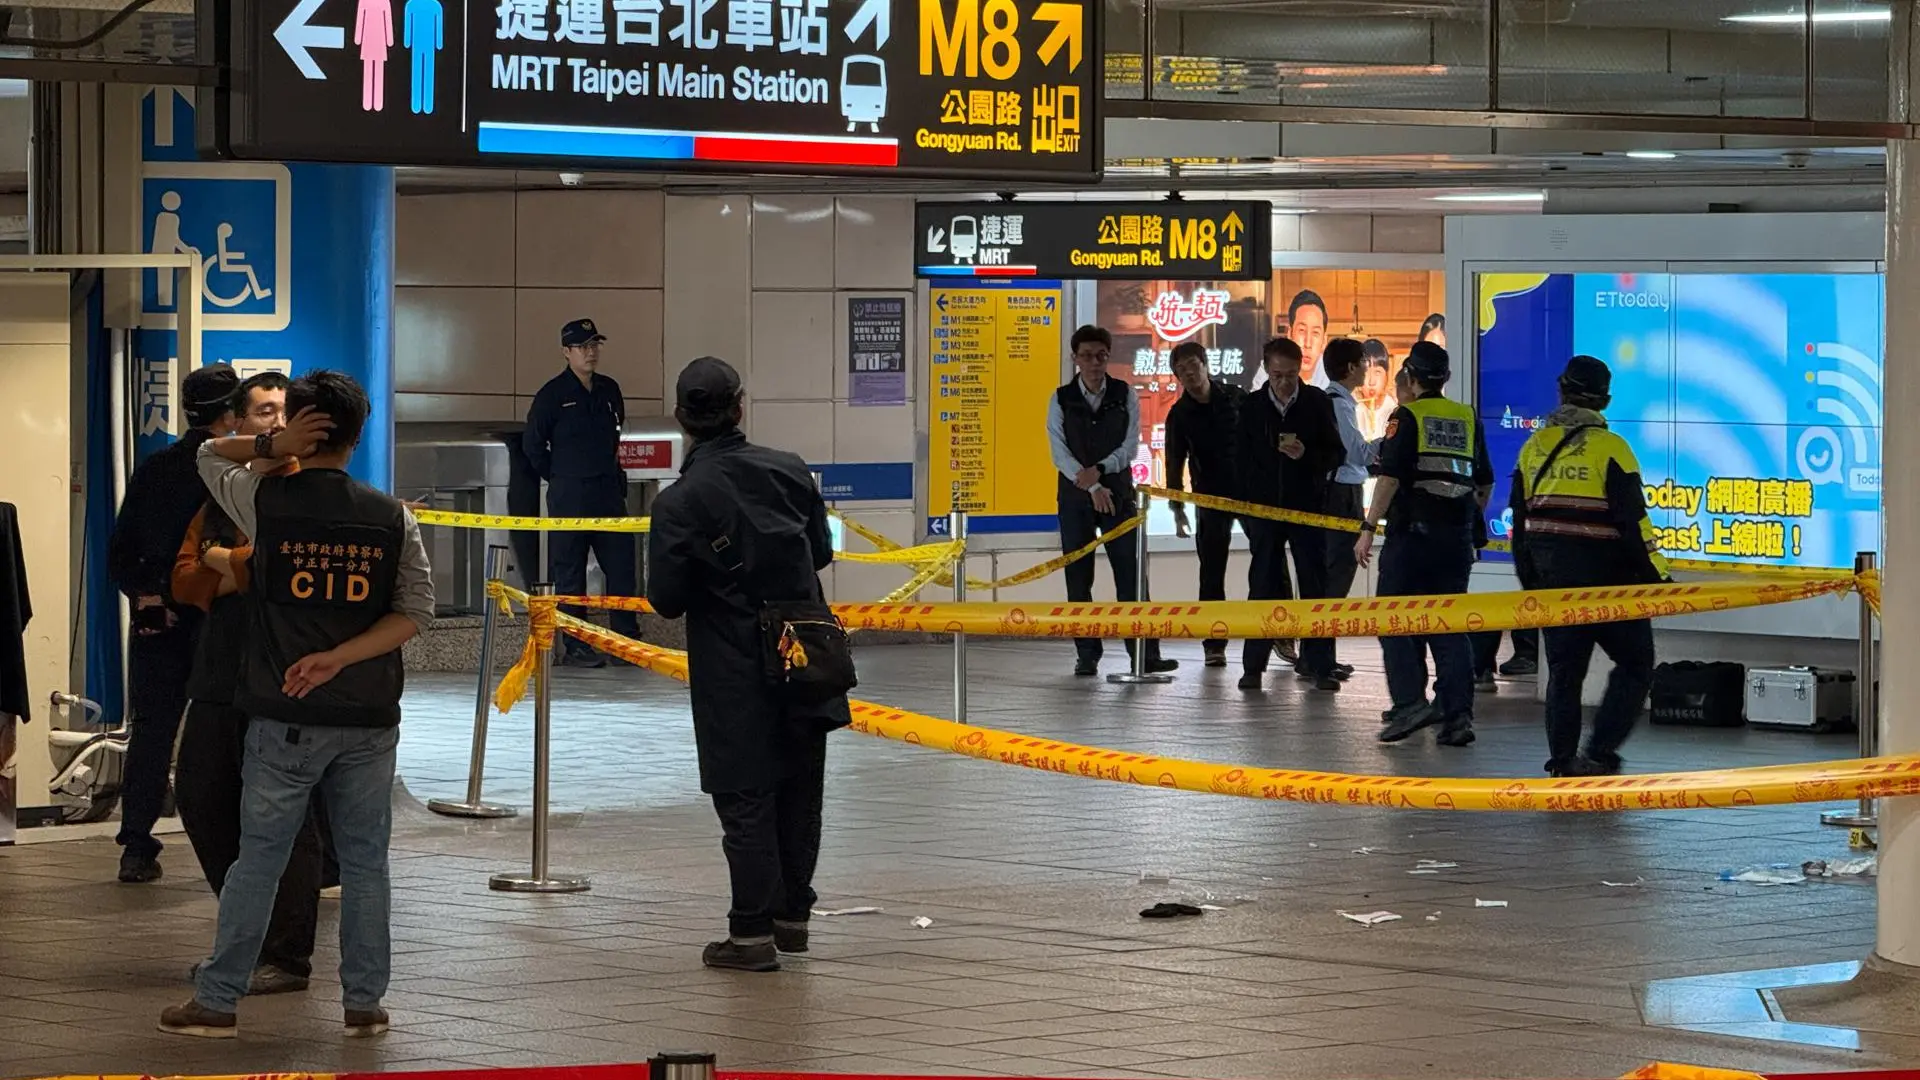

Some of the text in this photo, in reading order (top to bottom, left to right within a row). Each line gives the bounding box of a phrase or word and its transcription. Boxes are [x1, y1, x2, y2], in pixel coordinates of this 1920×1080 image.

[496, 0, 828, 56] 捷運台北車站
[919, 0, 1020, 80] M8
[492, 54, 828, 103] MRT Taipei Main Station
[940, 89, 1022, 126] 公園路
[1031, 84, 1080, 153] 出口
[915, 127, 1022, 153] Gongyuan Rd.
[1056, 134, 1081, 153] EXIT
[980, 215, 1024, 246] 捷運
[1097, 215, 1164, 245] 公園路
[1169, 218, 1217, 260] M8
[979, 248, 1010, 265] MRT
[1070, 249, 1164, 269] Gongyuan Rd.
[1151, 294, 1223, 328] 統一麵
[1596, 290, 1669, 313] ETtoday
[1133, 349, 1244, 376] 熟悉美味
[1530, 465, 1589, 481] PLICE
[1643, 479, 1703, 516] oday
[1706, 477, 1813, 517] 網路廣播
[279, 541, 384, 561] 臺北市政府警察局
[1652, 523, 1701, 550] cast
[293, 557, 371, 573] 中正第一分局
[290, 571, 370, 602] CID
[1387, 613, 1451, 634] 禁止進入
